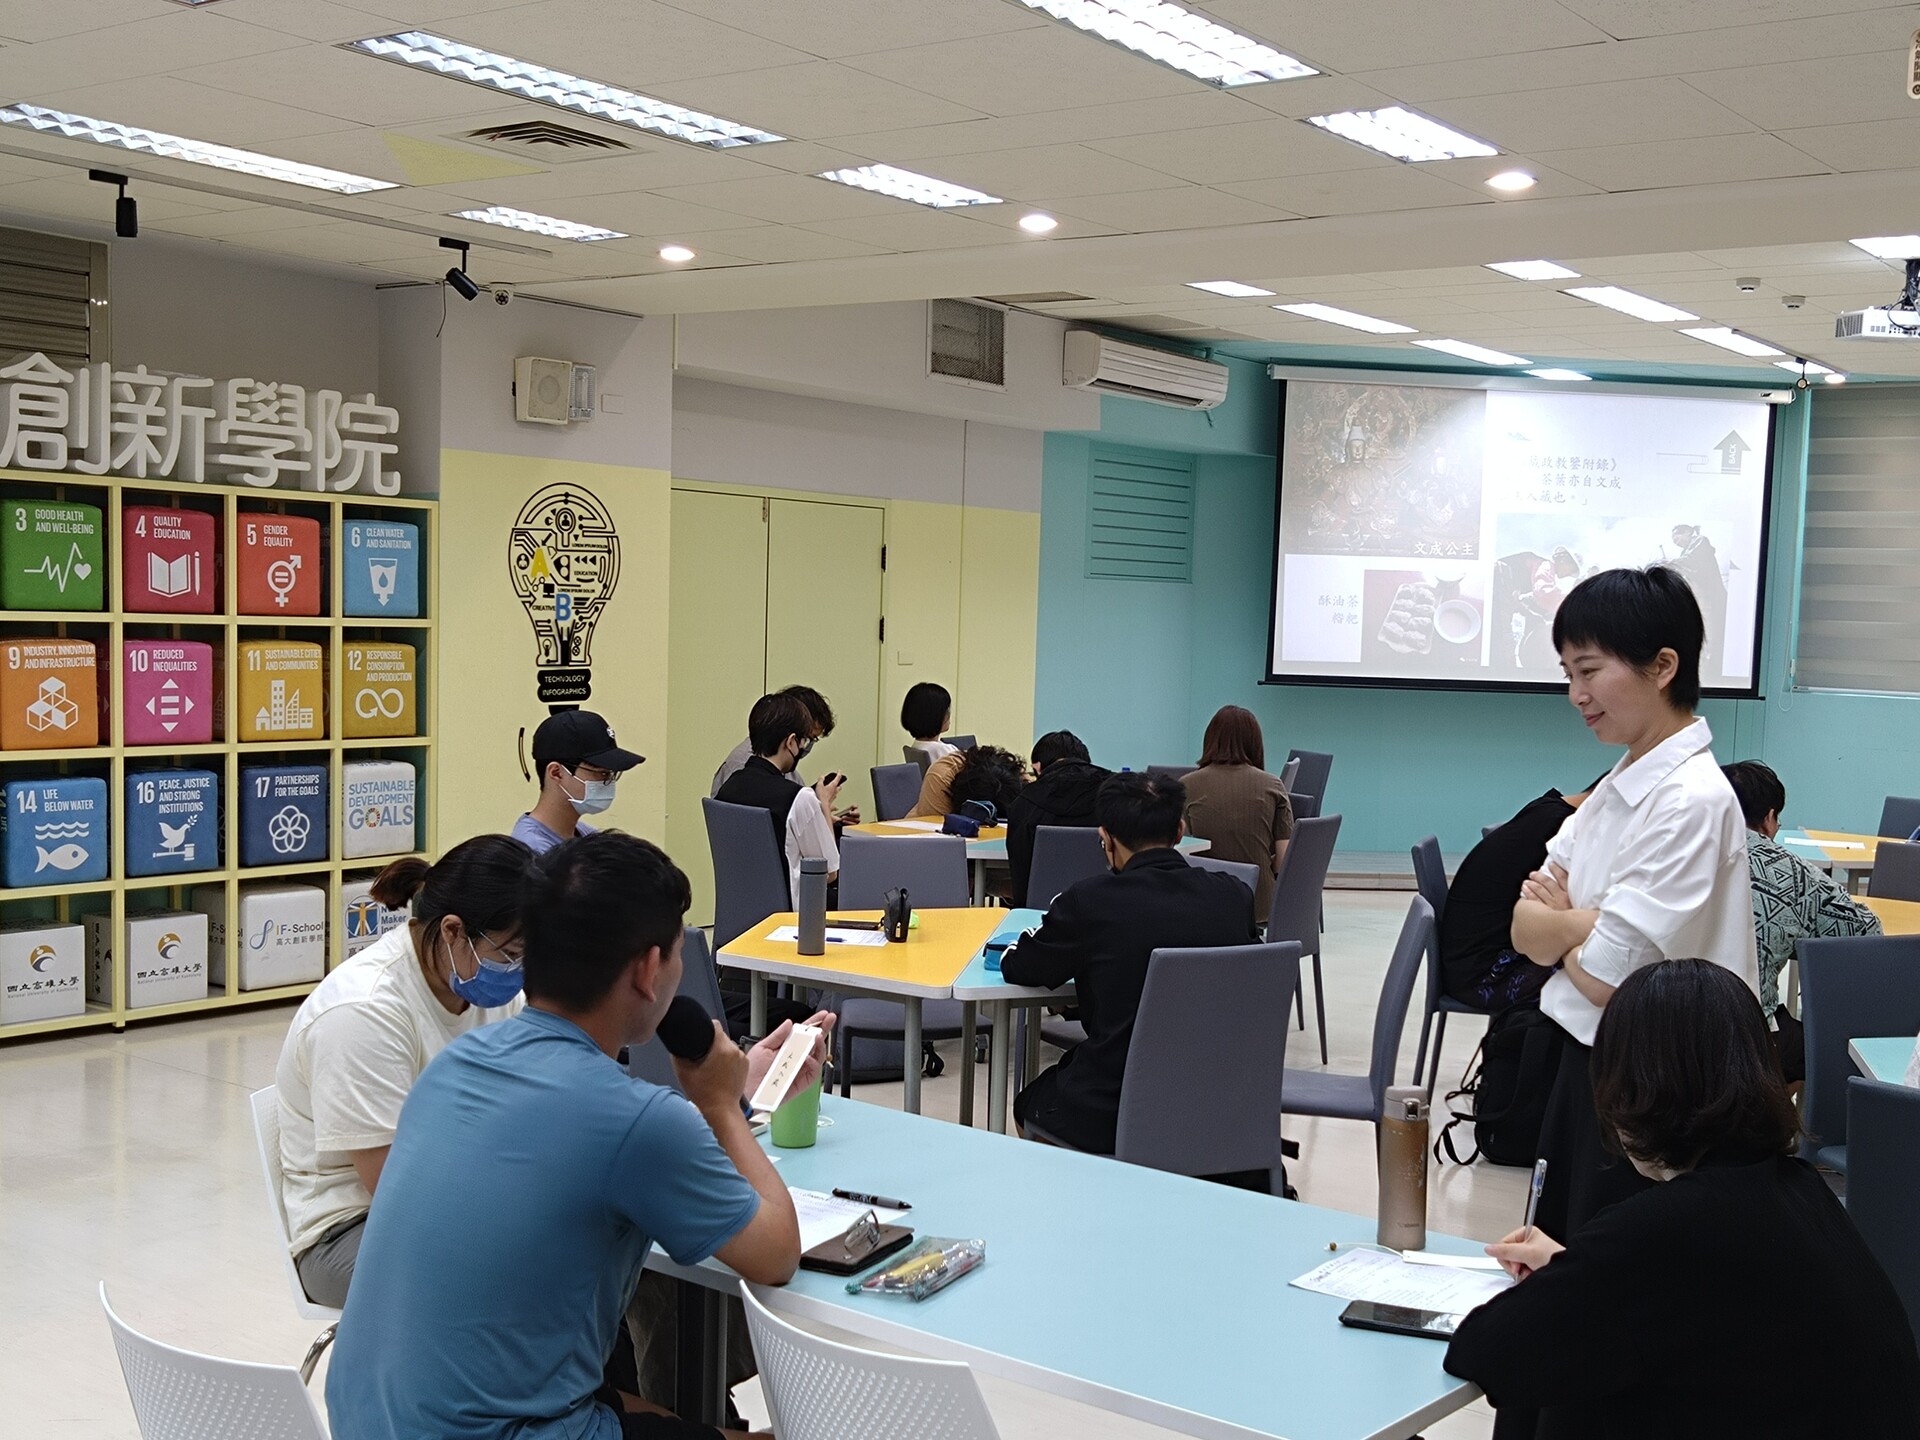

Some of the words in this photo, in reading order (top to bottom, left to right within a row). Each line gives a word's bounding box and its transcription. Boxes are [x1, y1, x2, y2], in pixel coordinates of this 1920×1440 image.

[0, 352, 401, 496] 創新學院
[1728, 443, 1737, 464] BACK
[15, 507, 27, 532] 3
[35, 508, 56, 520] GOOD
[57, 509, 84, 521] HEALTH
[135, 515, 147, 538] 4
[153, 515, 182, 528] QUALITY
[35, 522, 51, 533] AND
[52, 522, 94, 535] WELL-BEING
[153, 528, 191, 540] EDUCATION
[247, 523, 257, 545] 5
[263, 524, 289, 535] GENDER
[366, 527, 385, 537] CLEAN
[385, 528, 404, 539] WATER
[263, 537, 294, 548] EQUALITY
[351, 526, 361, 548] 6
[366, 539, 379, 548] AND
[380, 539, 412, 550] SANITATION
[1413, 541, 1475, 557] 文成公主
[530, 548, 550, 578] A
[555, 593, 572, 621] B
[1318, 594, 1359, 608] 酥油茶
[24, 646, 58, 657] INDUSTRY,
[58, 645, 96, 655] INNOVATION
[153, 649, 185, 660] REDUCED
[265, 649, 304, 659] SUSTAINABLE
[305, 649, 322, 659] CITIES
[366, 650, 402, 660] RESPONSIBLE
[8, 646, 21, 670] 9
[24, 658, 40, 669] AND
[40, 657, 95, 669] INFRASTRUCTURE
[129, 649, 149, 672] 10
[247, 650, 261, 671] 11
[347, 650, 362, 671] 12
[153, 661, 197, 672] INEQUALITIES
[265, 661, 279, 671] AND
[279, 660, 319, 670] COMMUNITIES
[366, 662, 405, 671] CONSUMPTION
[366, 673, 379, 682] AND
[379, 672, 412, 682] PRODUCTION
[544, 674, 586, 683] TECHNOLOGY
[542, 687, 587, 696] INFOGRAPHICS
[182, 777, 210, 788] JUSTICE
[274, 774, 320, 785] PARTNERSHIPS
[136, 781, 155, 804] 16
[255, 776, 270, 798] 17
[274, 787, 287, 797] FOR
[287, 786, 299, 796] THE
[299, 785, 319, 796] GOALS
[348, 780, 414, 795] SUSTAINABLE
[42, 789, 59, 800] LIFE
[159, 791, 173, 802] AND
[174, 790, 201, 801] STRONG
[348, 793, 414, 808] DEVELOPMENT
[16, 790, 38, 813] 14
[44, 801, 70, 812] BELOW
[70, 799, 94, 811] WATER
[159, 802, 204, 814] INSTITUTIONS
[349, 805, 414, 830] GOALS
[381, 915, 407, 925] Maker
[276, 922, 324, 936] IF-School
[276, 935, 324, 946] 高大創新學院
